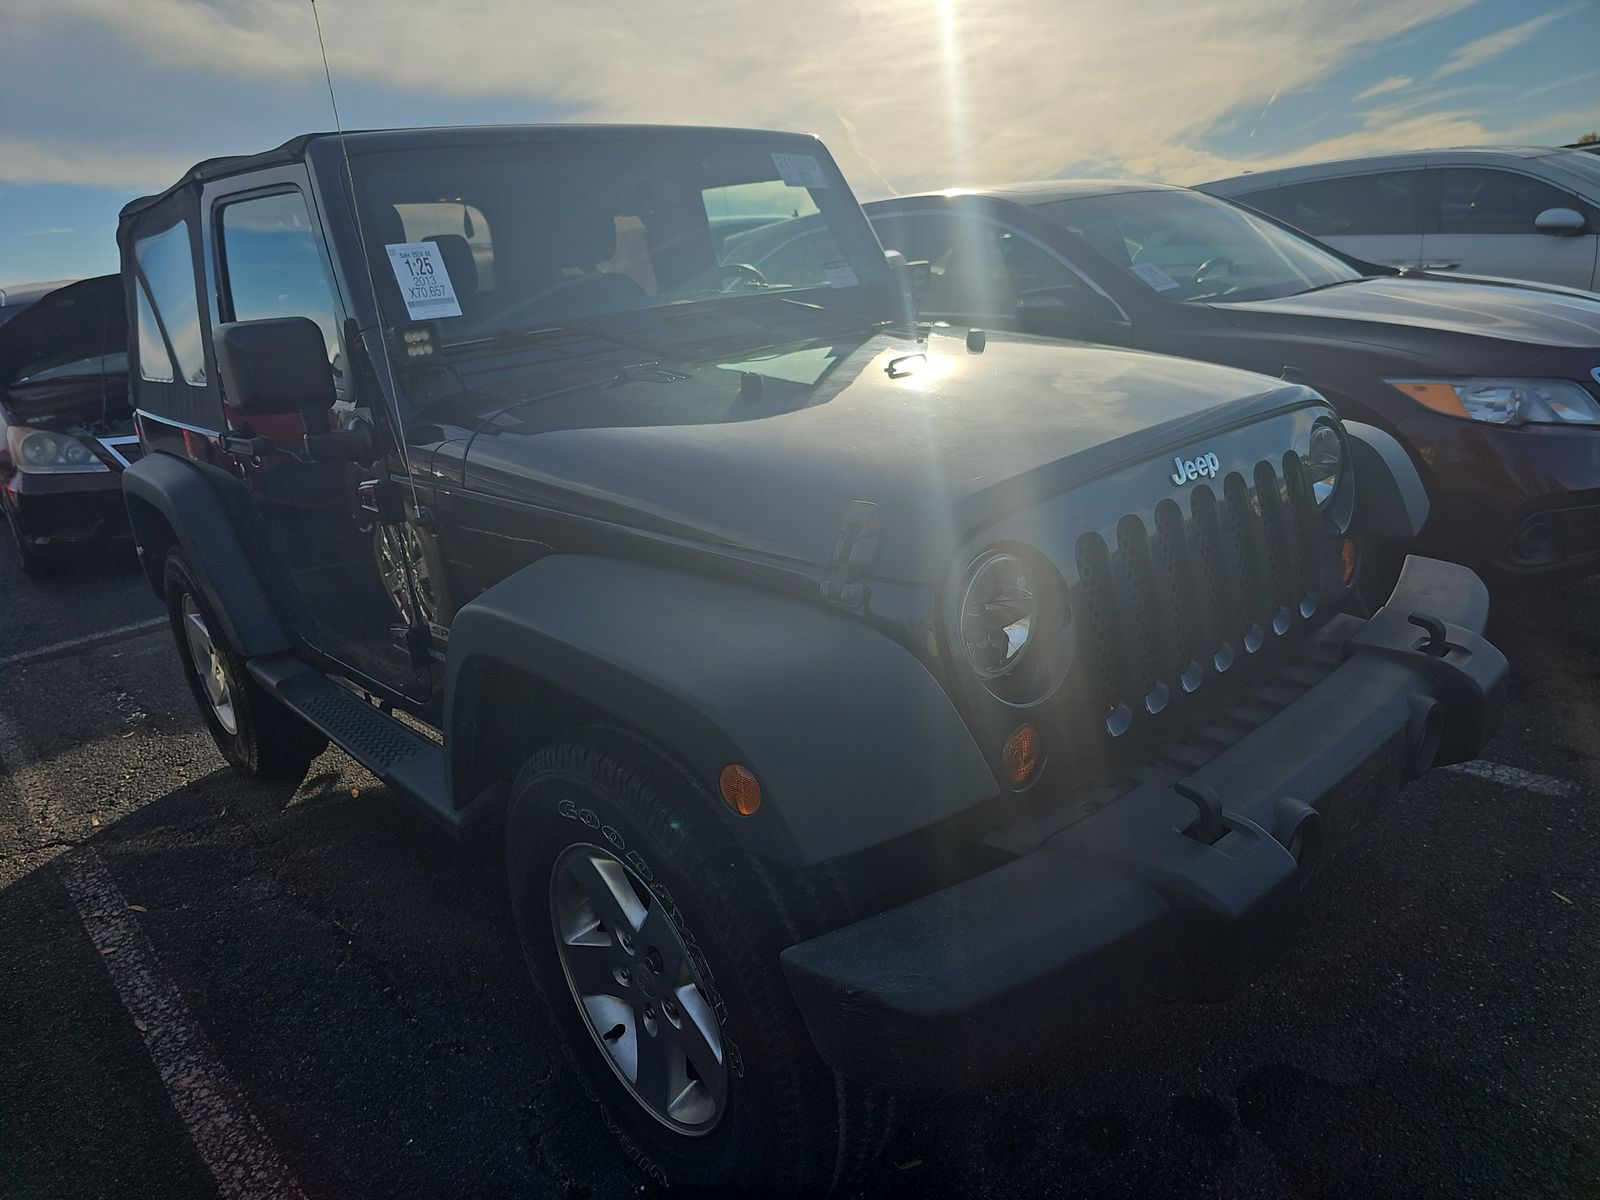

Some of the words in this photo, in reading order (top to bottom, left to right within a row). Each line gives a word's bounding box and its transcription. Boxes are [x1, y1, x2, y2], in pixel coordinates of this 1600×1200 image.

[405, 257, 433, 276] 1:25
[413, 275, 437, 287] 2013
[408, 285, 446, 299] X70.657
[1172, 452, 1220, 486] Jeep
